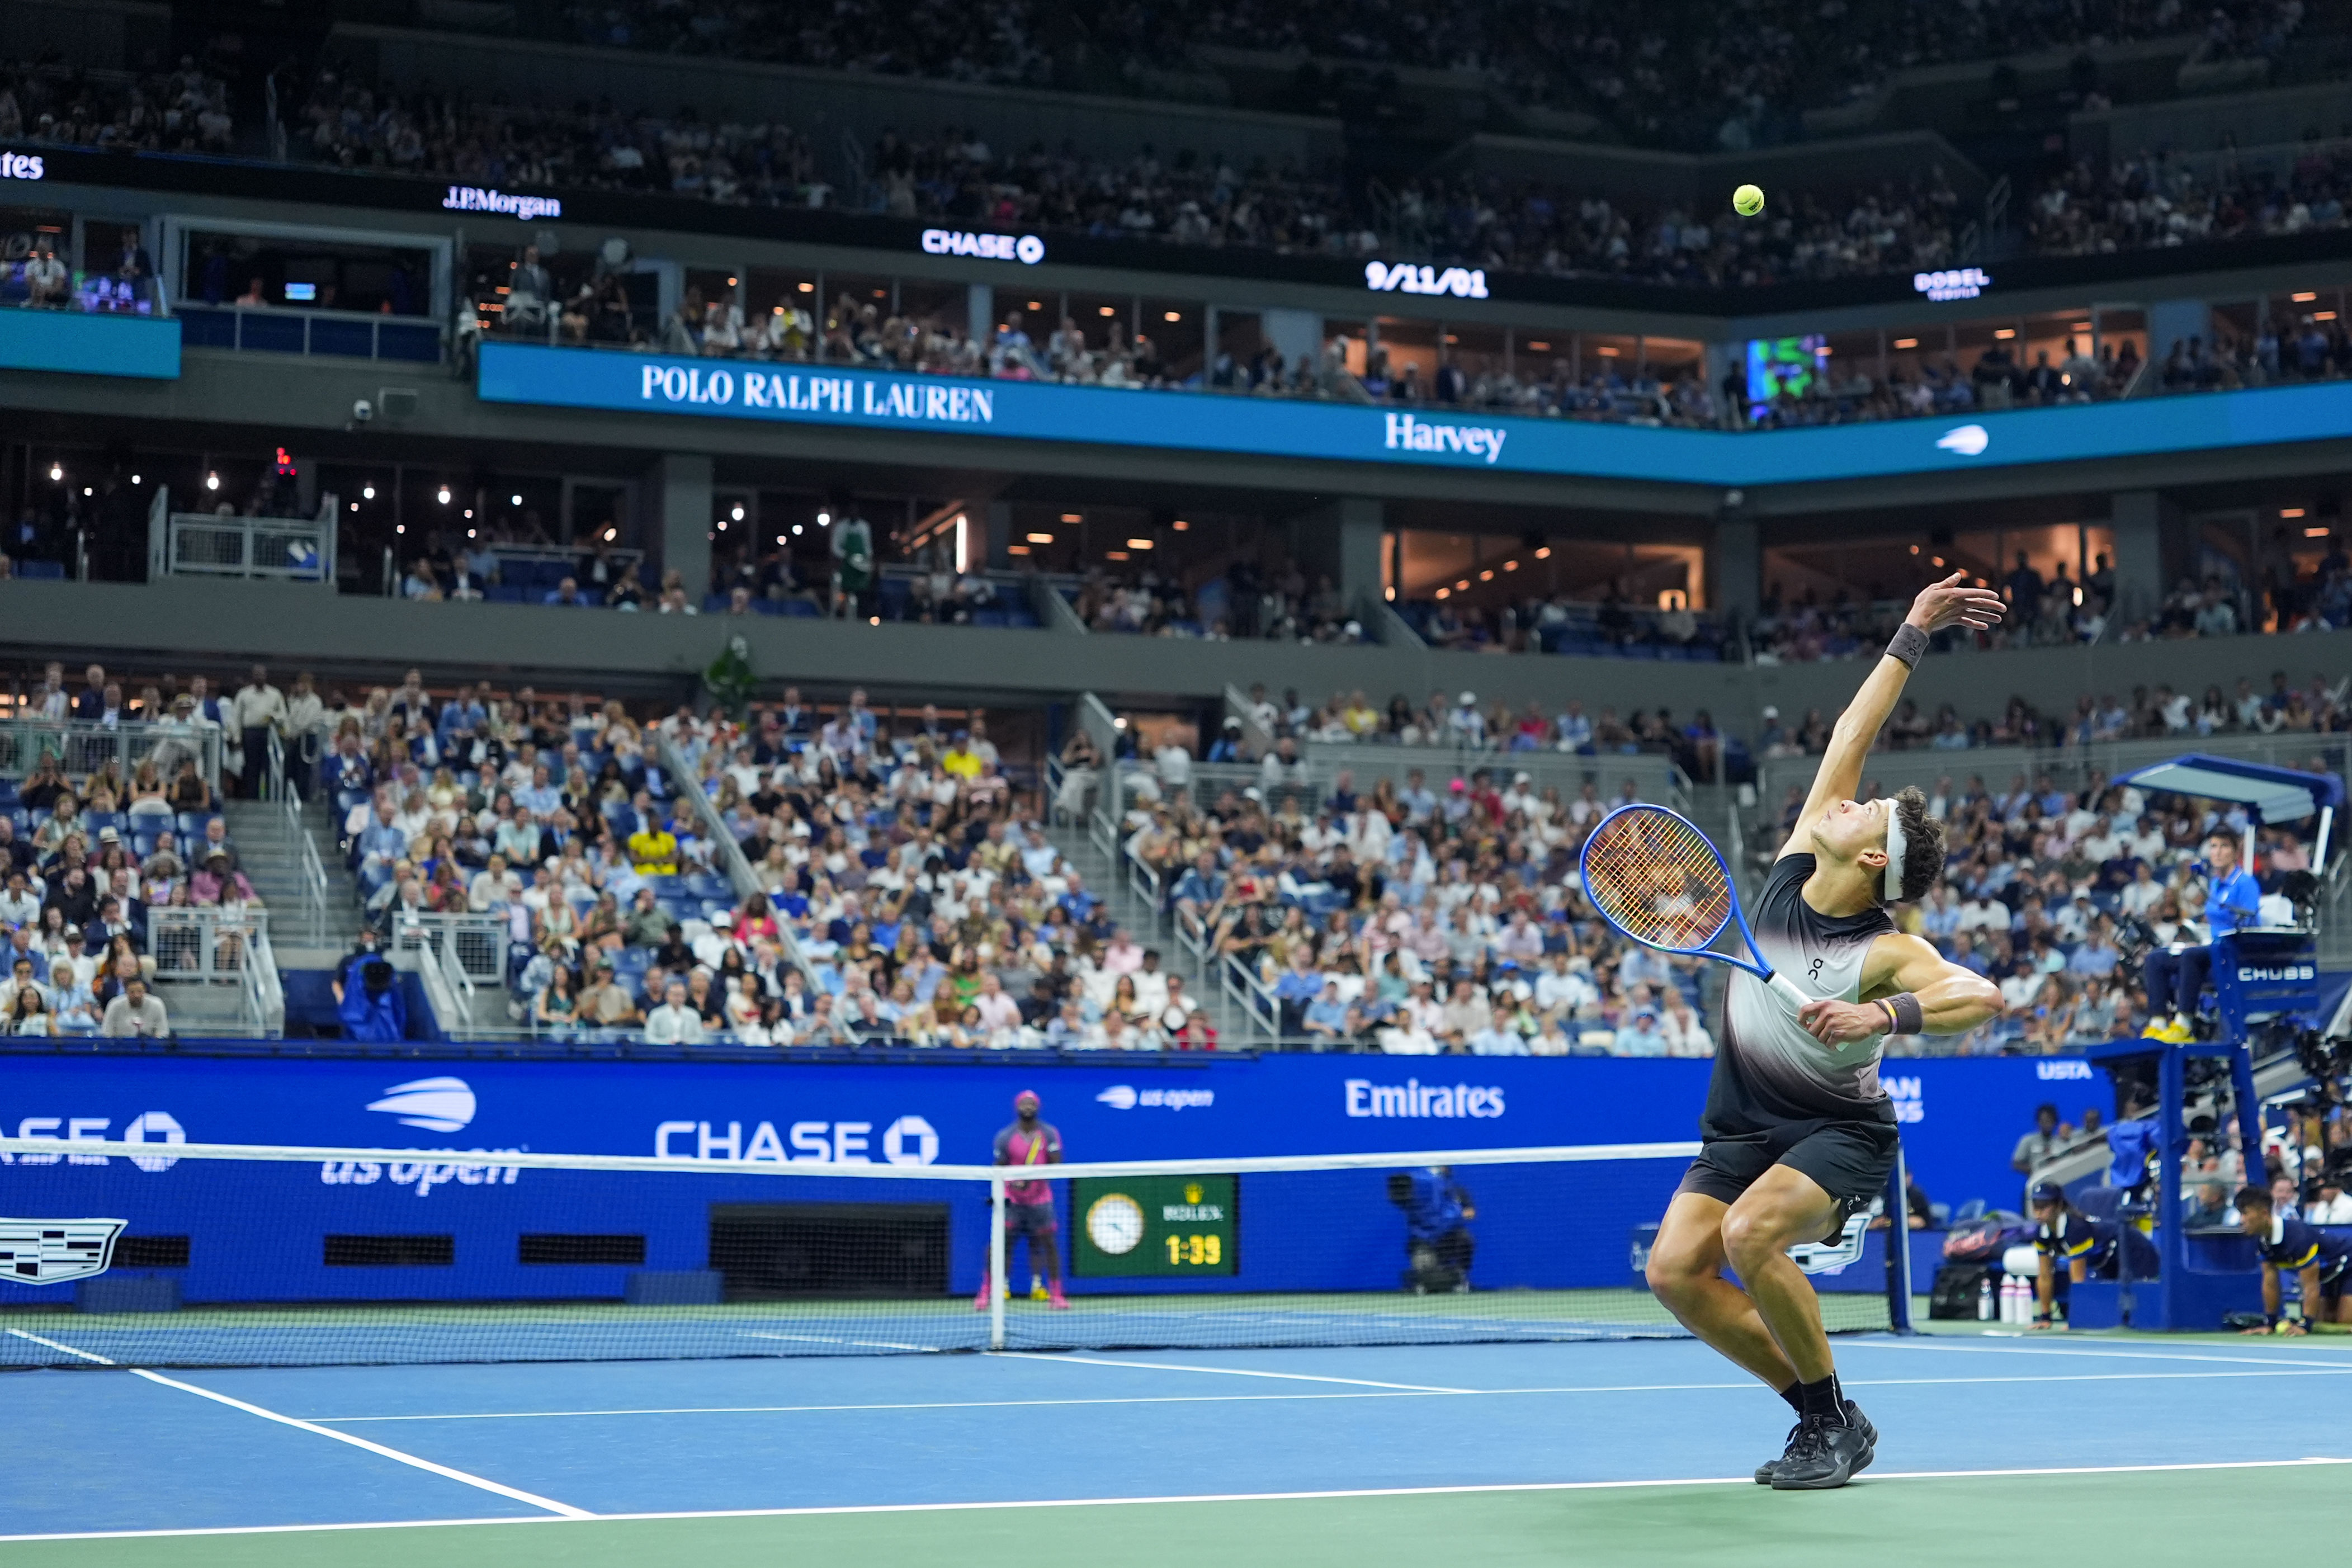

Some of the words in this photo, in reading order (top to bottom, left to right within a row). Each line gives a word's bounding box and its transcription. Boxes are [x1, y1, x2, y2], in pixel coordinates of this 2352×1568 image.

[0, 151, 44, 180] tes
[922, 229, 1017, 260] CHASE
[1365, 261, 1489, 299] 9/11/01
[641, 365, 734, 405] POLO
[743, 372, 853, 413] RALPH
[863, 380, 994, 423] LAUREN
[1385, 413, 1506, 464] Harvey
[2238, 966, 2314, 981] CHUBB
[2037, 1060, 2093, 1080] USTA
[1344, 1077, 1505, 1118] Emirates
[655, 1121, 872, 1165] CHASE
[1166, 1235, 1221, 1265] 1:39
